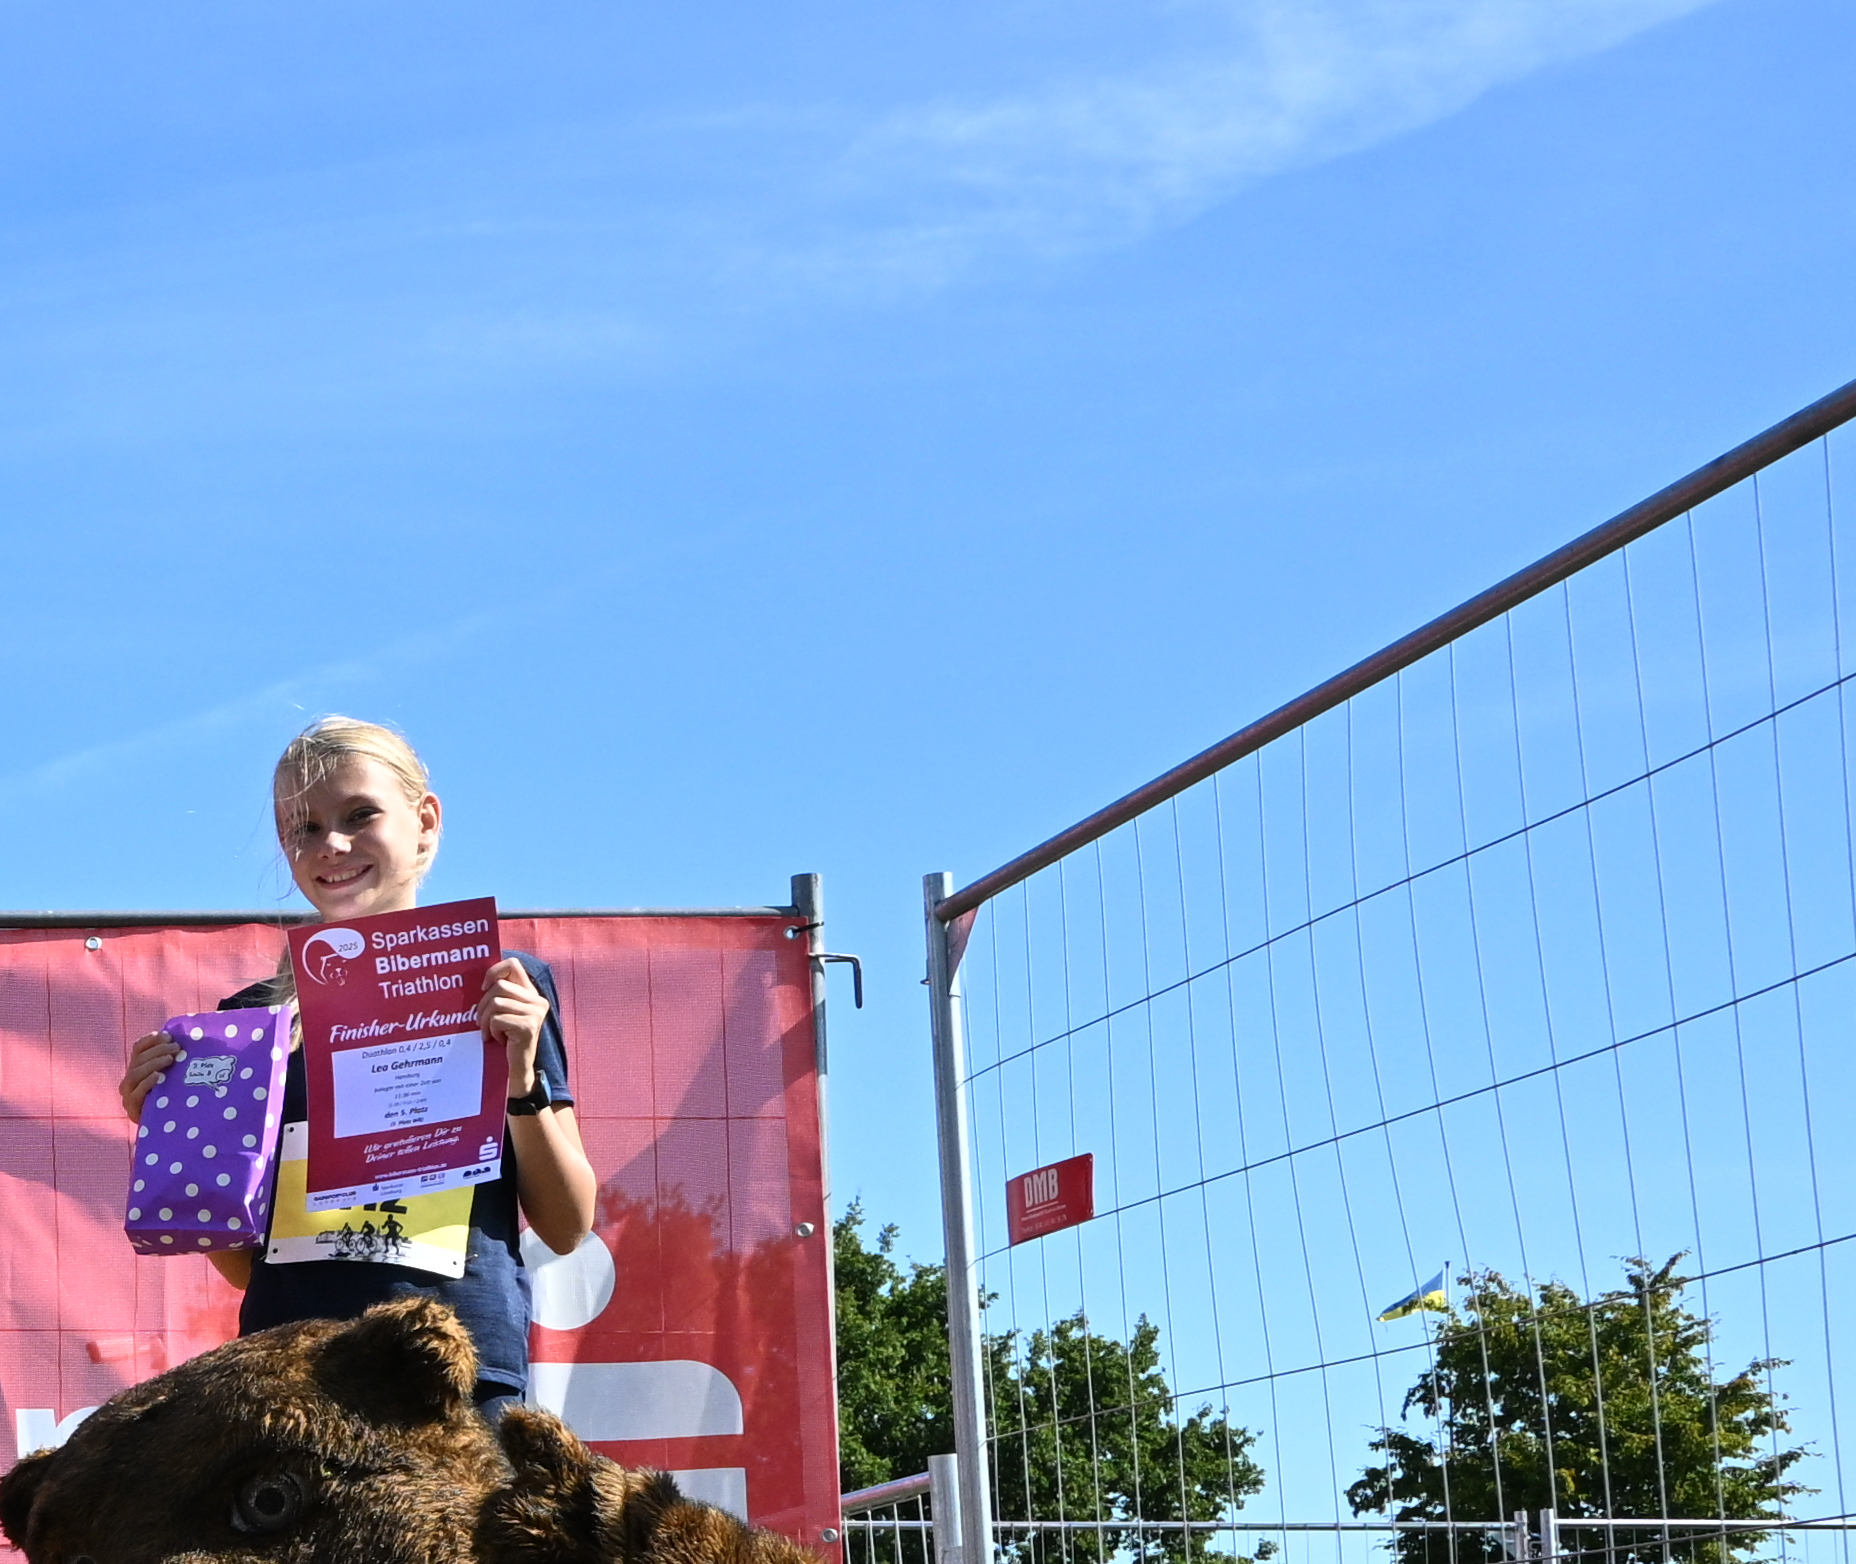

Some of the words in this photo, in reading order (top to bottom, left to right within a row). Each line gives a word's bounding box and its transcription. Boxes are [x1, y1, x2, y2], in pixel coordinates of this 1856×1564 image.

[337, 941, 358, 952] 2025
[371, 913, 489, 953] Sparkassen
[376, 939, 489, 975] Bibermann
[379, 969, 463, 1000] Triathlon
[361, 1046, 396, 1059] Duathlon
[371, 1062, 388, 1074] Lea
[390, 1052, 442, 1071] Gehrmann
[1024, 1167, 1059, 1208] DMB
